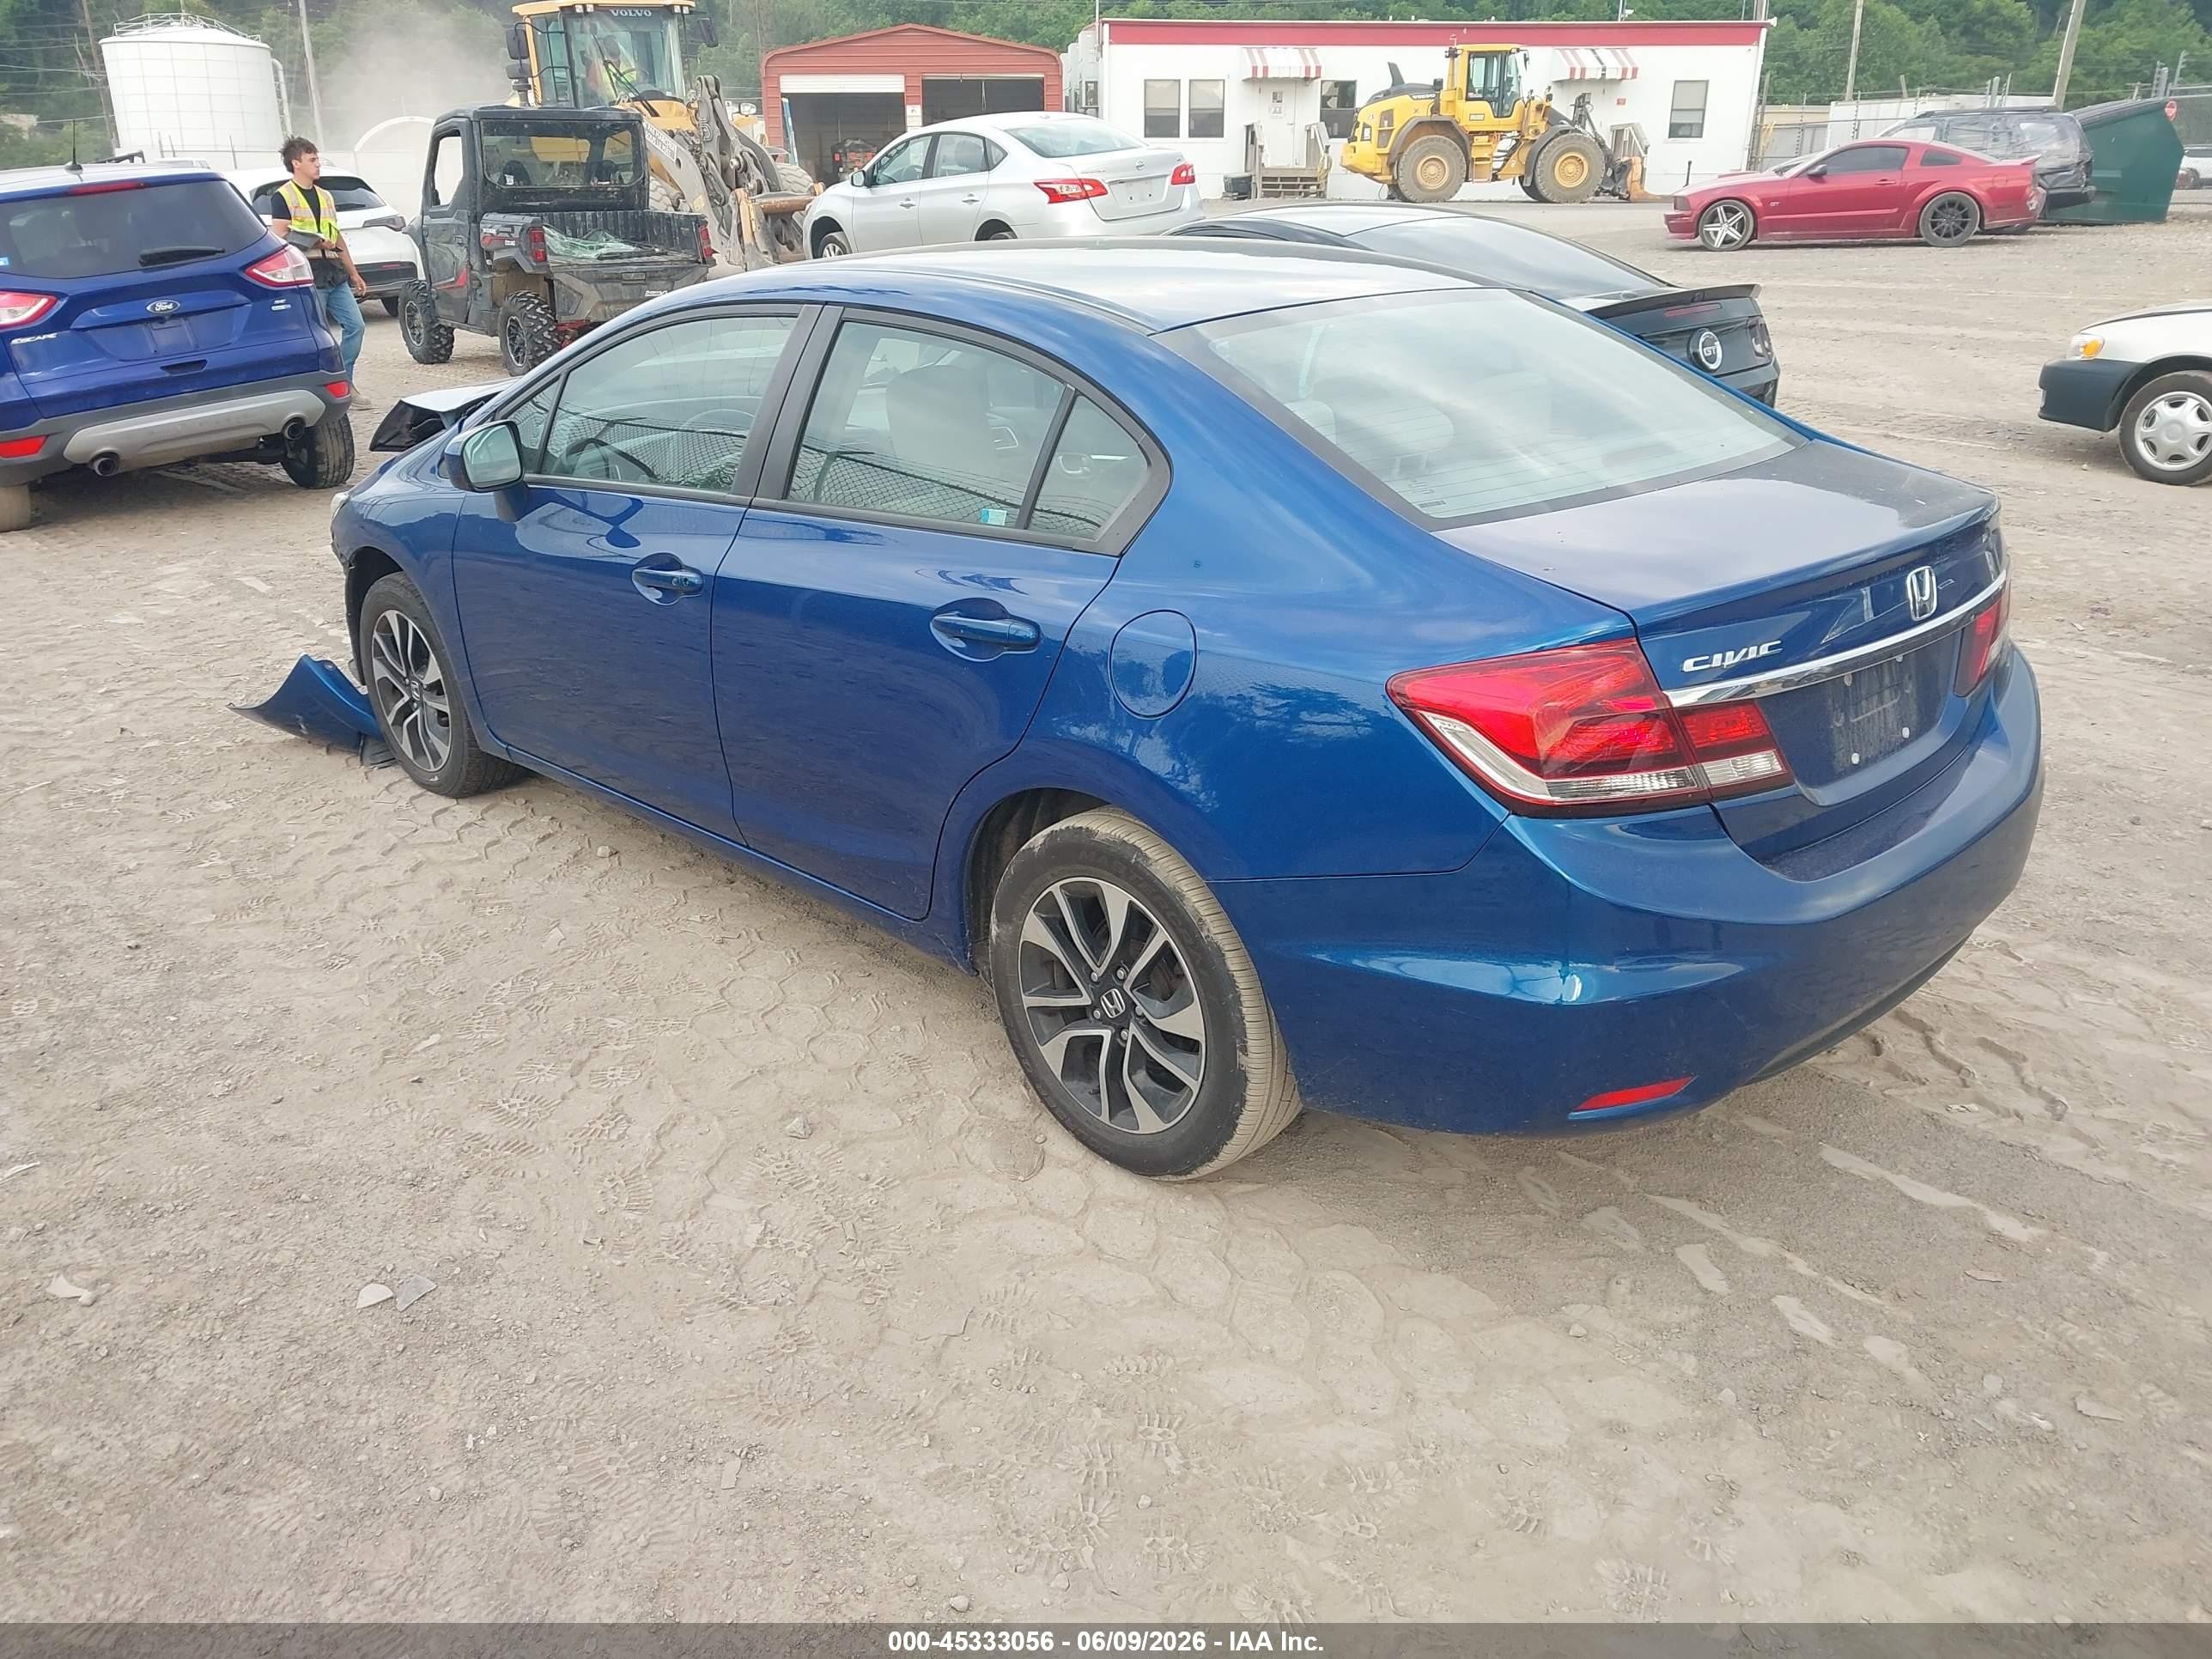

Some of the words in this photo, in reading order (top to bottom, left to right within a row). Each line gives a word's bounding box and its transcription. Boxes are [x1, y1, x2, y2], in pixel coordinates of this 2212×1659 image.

[610, 9, 653, 17] VOLVO
[155, 301, 174, 312] Ford
[10, 332, 58, 345] ESCAPE
[1703, 345, 1717, 357] GT
[1682, 640, 1784, 672] CIVIC
